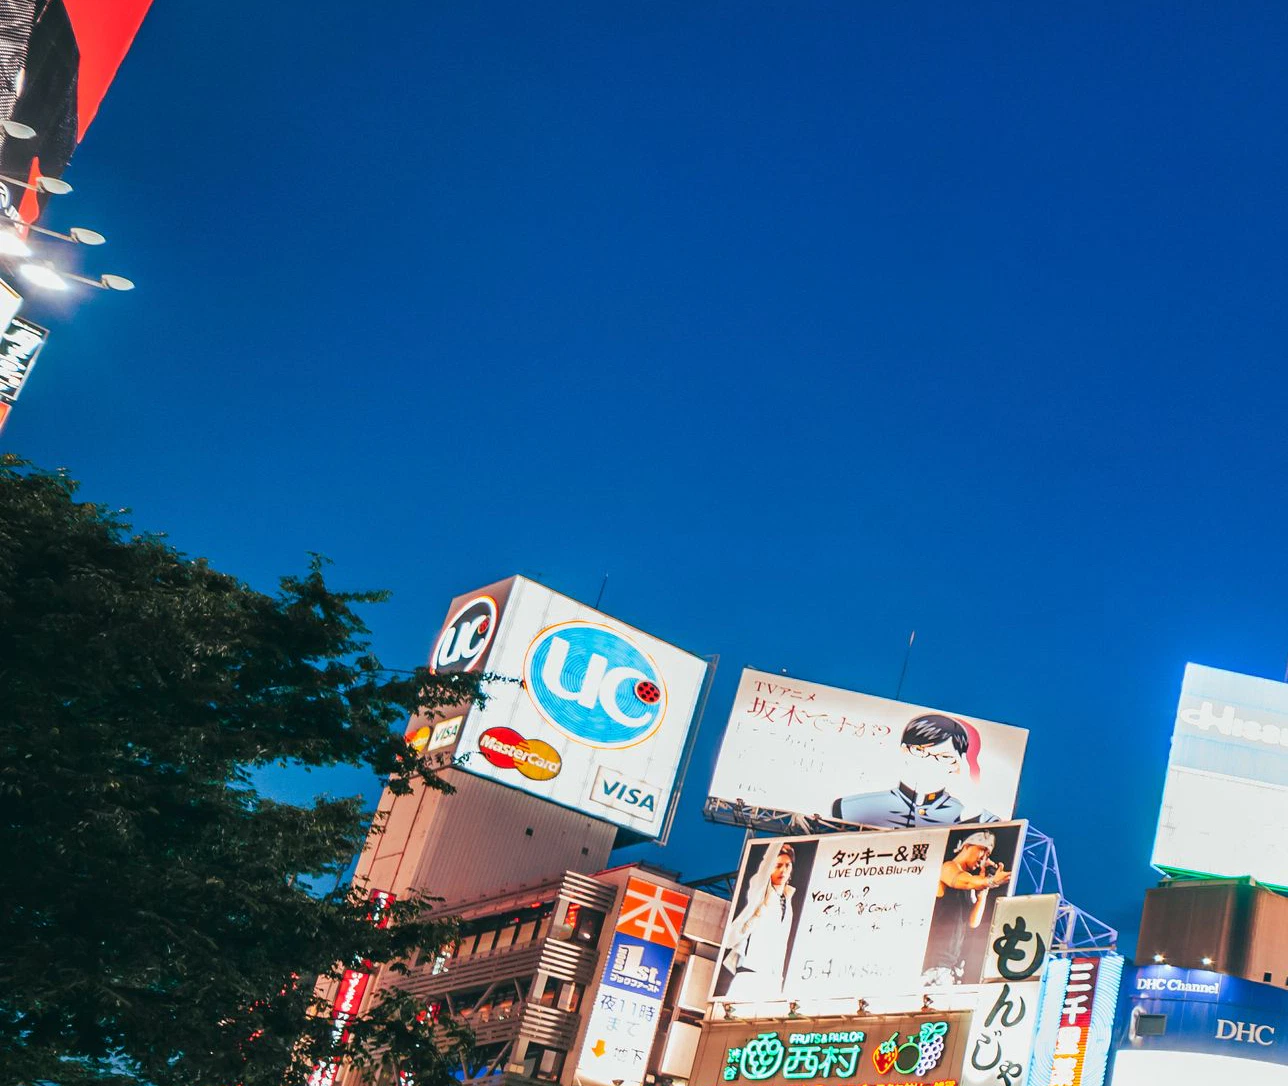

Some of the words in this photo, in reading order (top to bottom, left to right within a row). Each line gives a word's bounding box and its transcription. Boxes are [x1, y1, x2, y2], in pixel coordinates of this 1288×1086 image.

[479, 733, 561, 774] MasterCard
[601, 779, 655, 813] VISA
[831, 843, 930, 867] タッキー&翼
[828, 868, 851, 879] LIVE
[855, 864, 924, 877] DVD&Blu-ray
[617, 885, 688, 946] 本
[610, 974, 660, 993] ブックファースト
[1136, 978, 1166, 991] DHC
[1167, 979, 1220, 995] Channel
[789, 1031, 865, 1045] FRUITS&PARLOR
[1215, 1018, 1275, 1046] DHC
[783, 1045, 862, 1079] 西村
